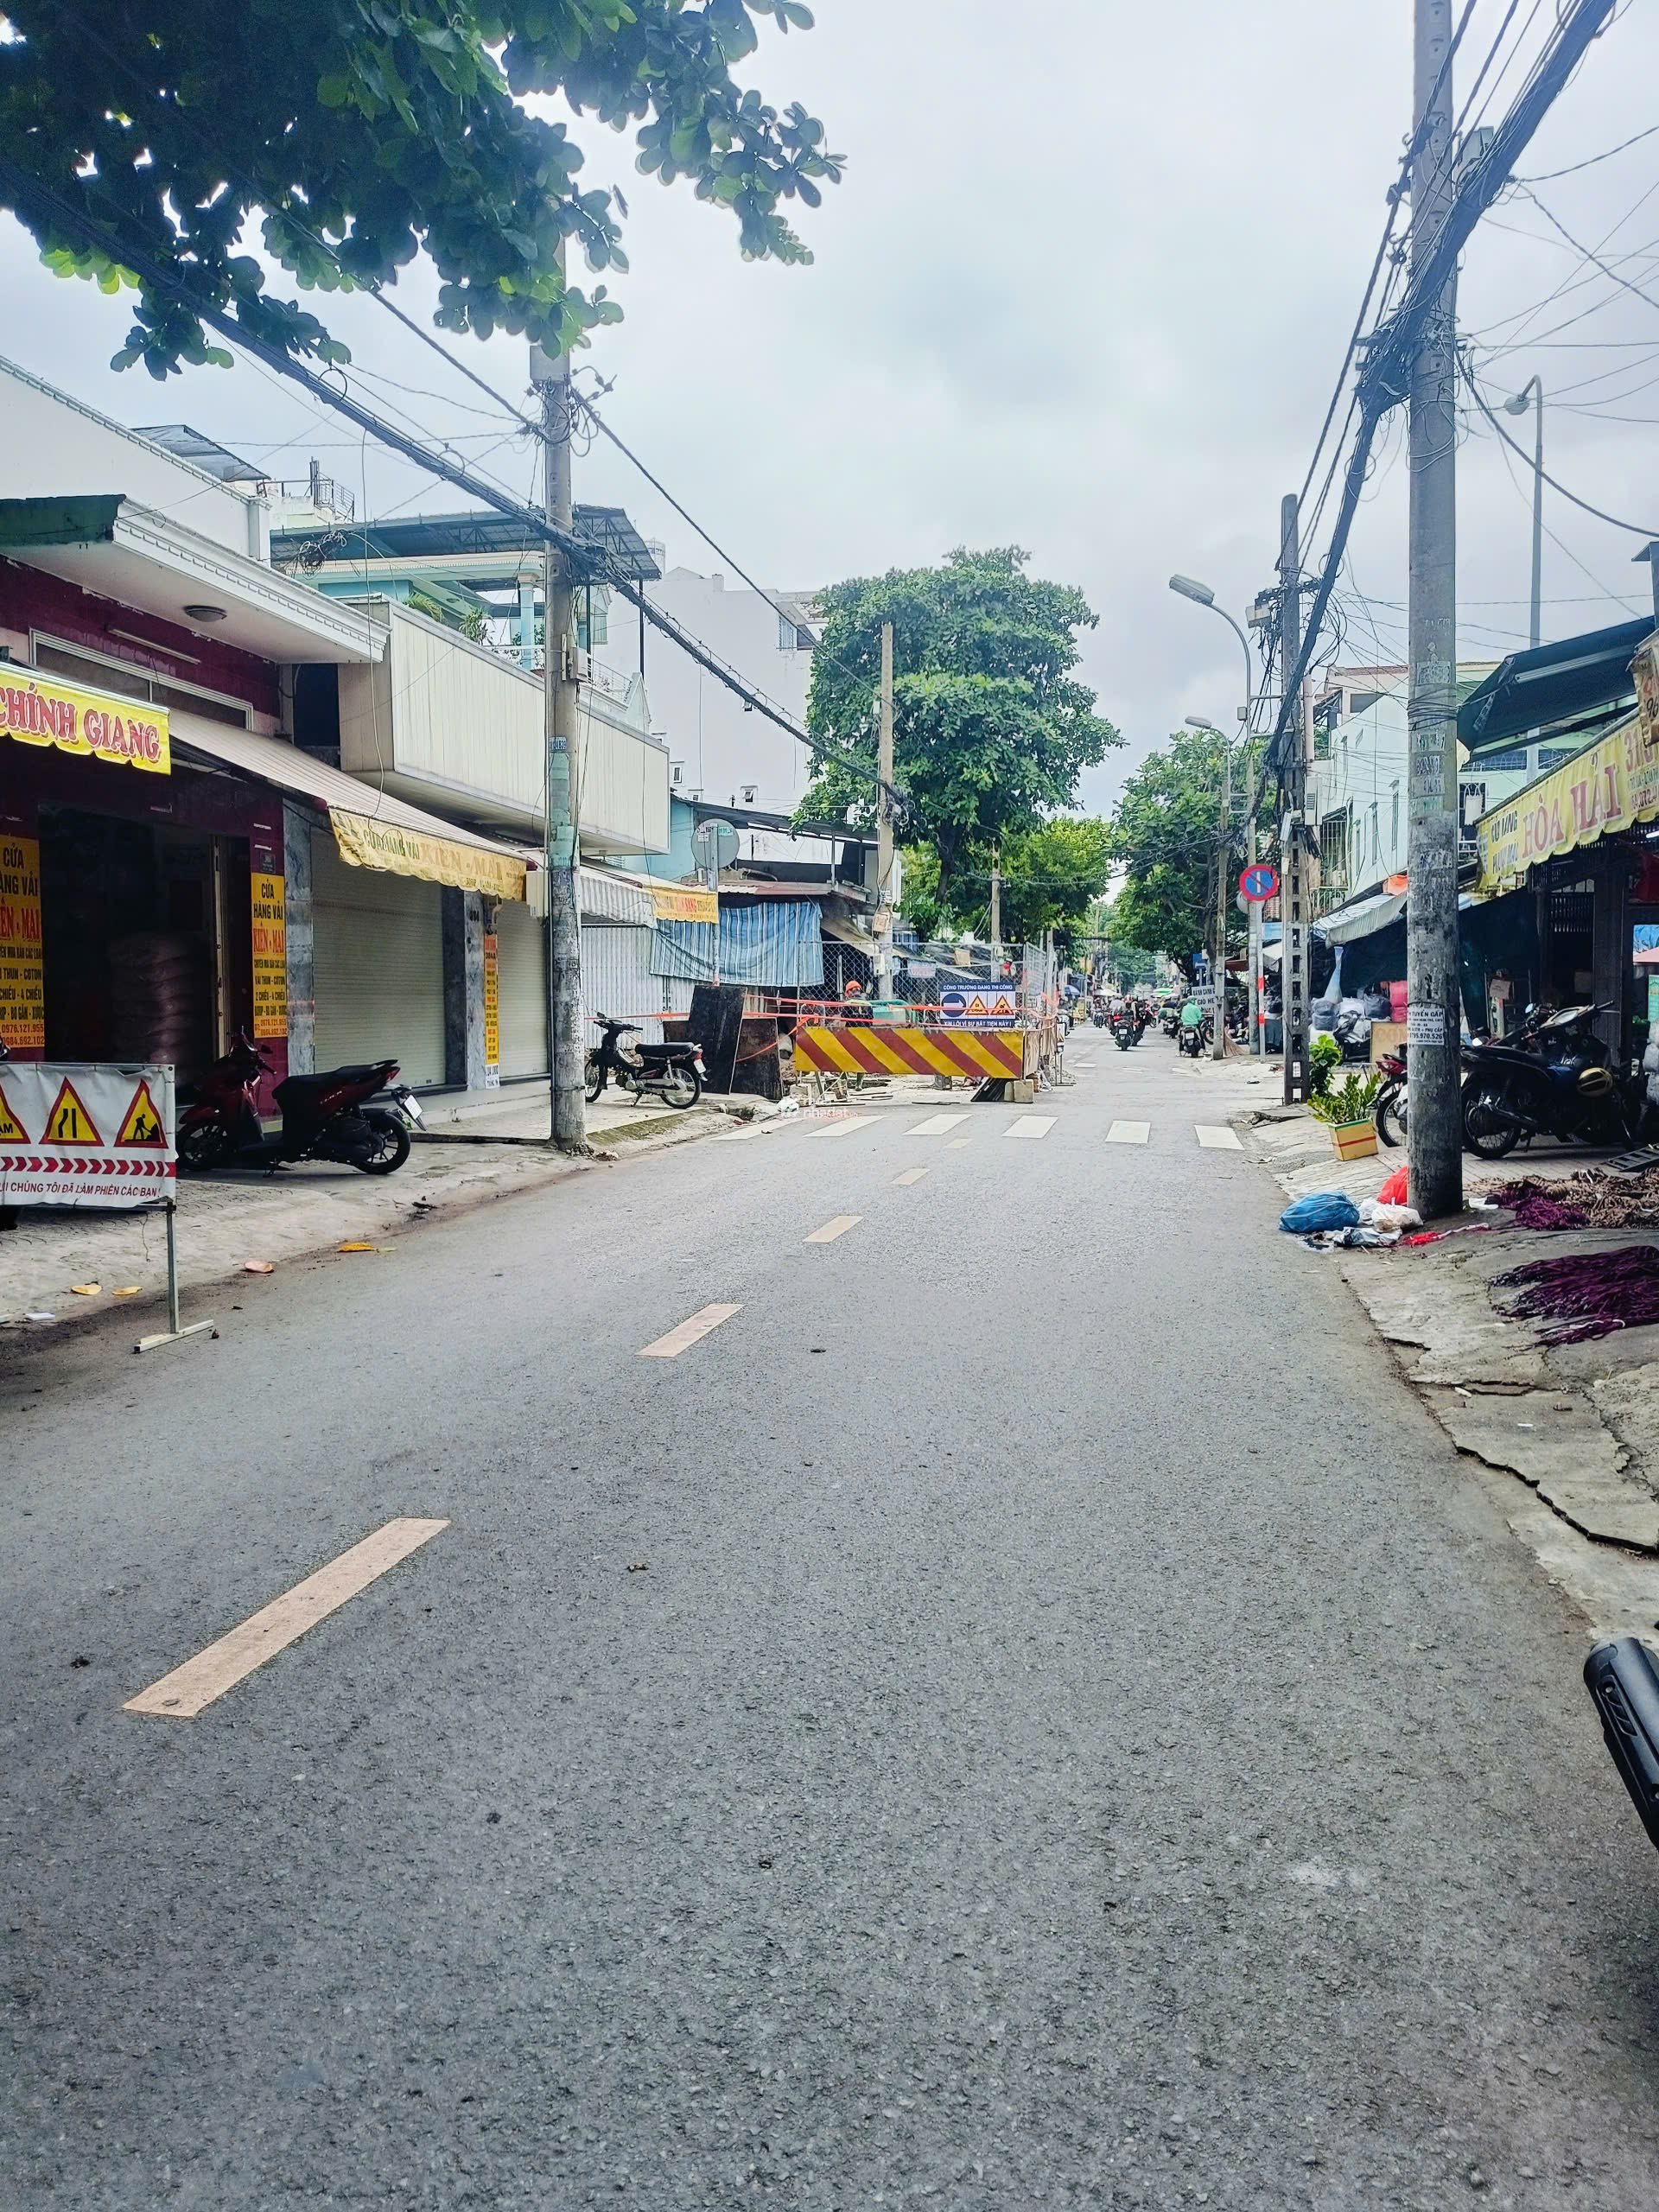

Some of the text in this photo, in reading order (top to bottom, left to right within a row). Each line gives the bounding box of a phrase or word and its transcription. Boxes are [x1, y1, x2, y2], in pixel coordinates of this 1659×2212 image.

[84, 708, 161, 763] GIANG
[1522, 793, 1566, 860] HÒA
[1571, 752, 1622, 834] HẢI
[3, 843, 24, 869] CỬA
[22, 871, 38, 897] VẢI
[261, 878, 275, 899] CỬA
[253, 900, 283, 920] HÀNG VẢI
[22, 907, 41, 941] MAI
[272, 930, 284, 955] MAI
[3, 968, 18, 980] THUN
[10, 1180, 43, 1192] CHÚNG
[46, 1181, 60, 1193] TÔI
[61, 1182, 73, 1193] ĐÃ
[75, 1182, 93, 1194] LÀM
[120, 1185, 138, 1197] CÁC
